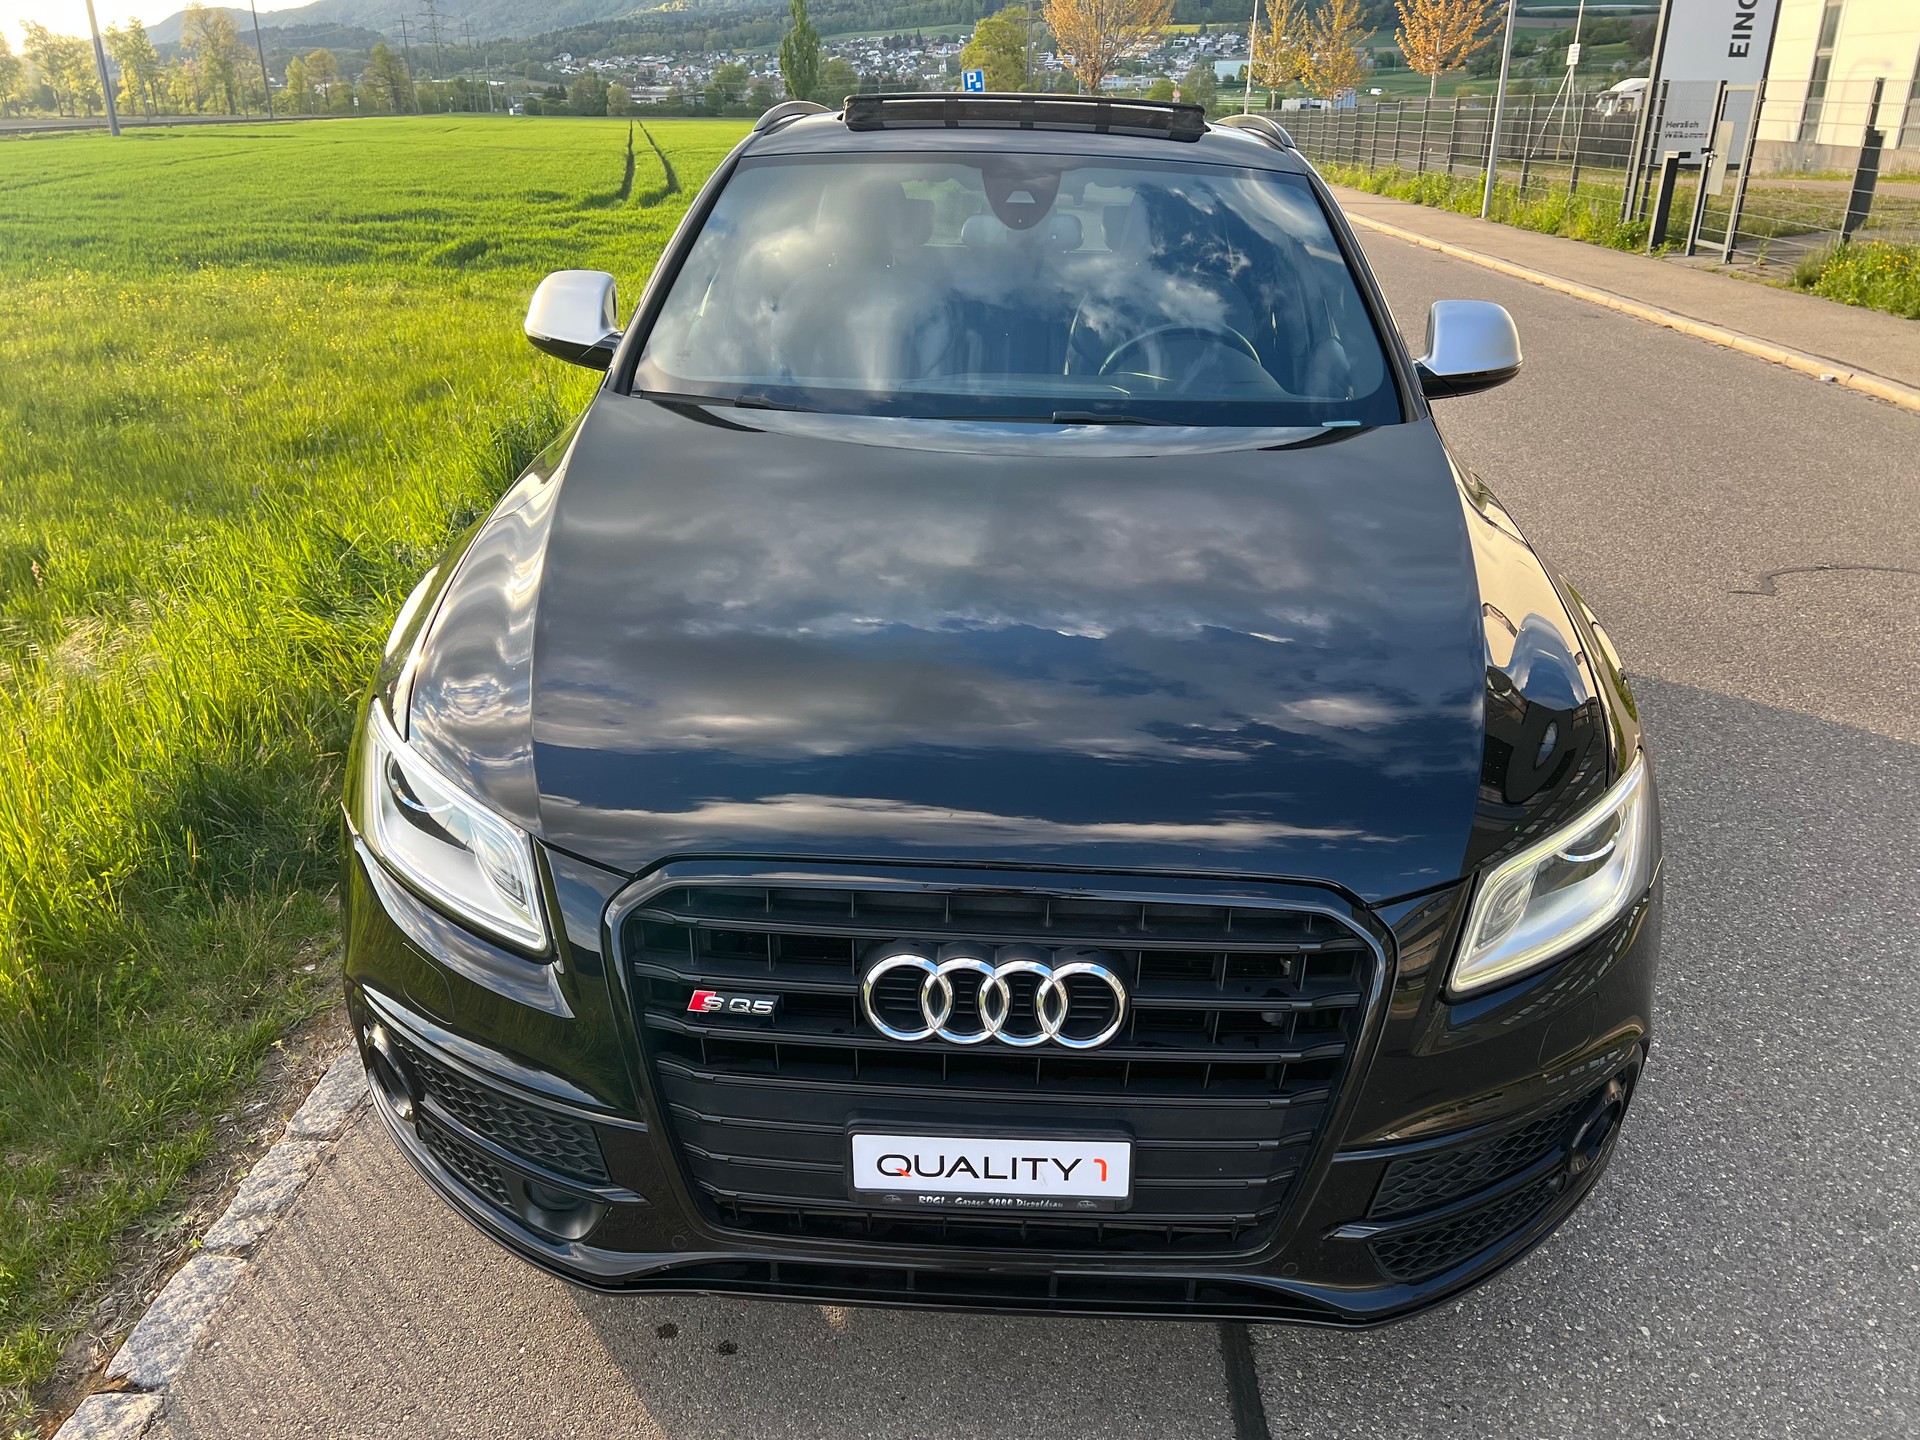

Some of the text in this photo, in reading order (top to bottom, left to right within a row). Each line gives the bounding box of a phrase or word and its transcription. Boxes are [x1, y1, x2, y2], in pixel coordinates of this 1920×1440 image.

[967, 72, 977, 89] P
[1665, 120, 1699, 128] Herzlich
[876, 1153, 1108, 1182] QUALITY 1
